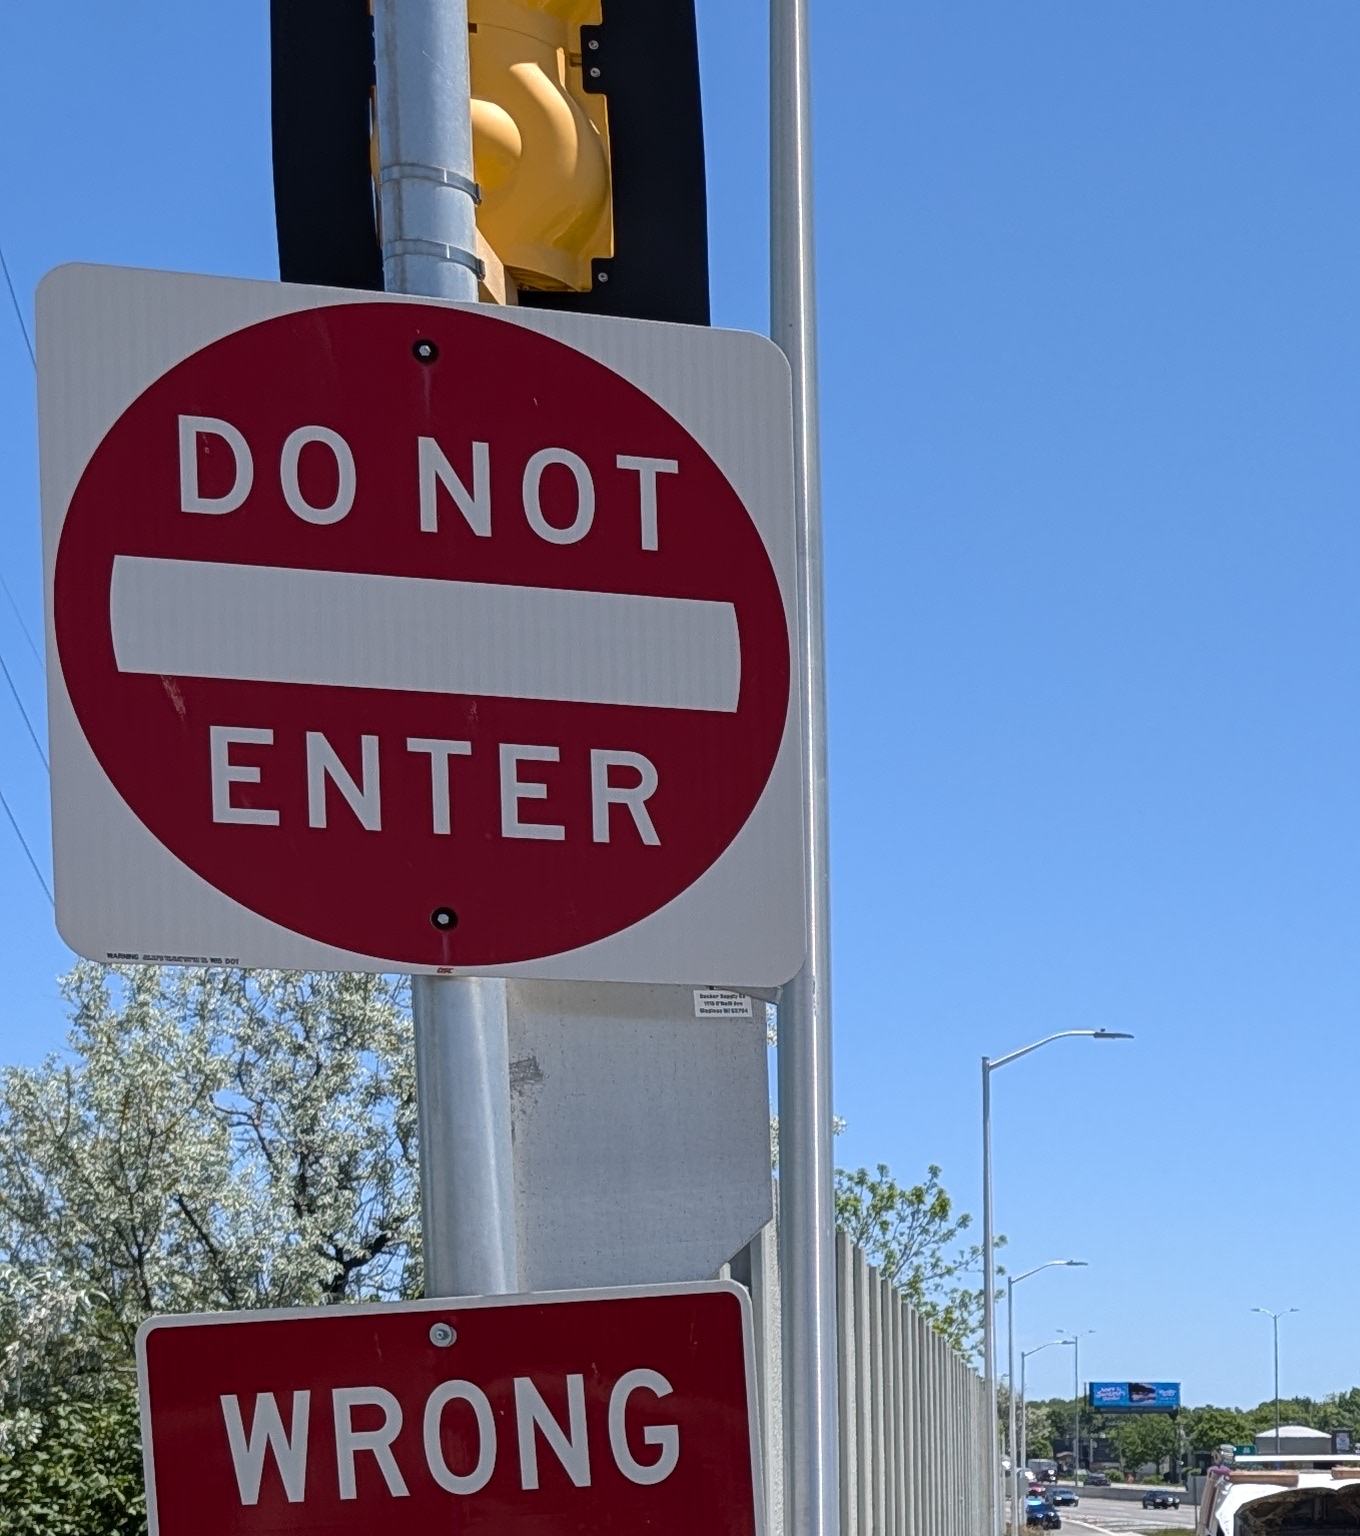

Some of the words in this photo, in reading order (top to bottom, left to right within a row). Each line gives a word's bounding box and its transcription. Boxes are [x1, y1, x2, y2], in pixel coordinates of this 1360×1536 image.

[178, 414, 357, 526] DO
[417, 436, 679, 552] NOT
[209, 725, 662, 846] ENTER
[219, 1367, 680, 1507] WRONG
